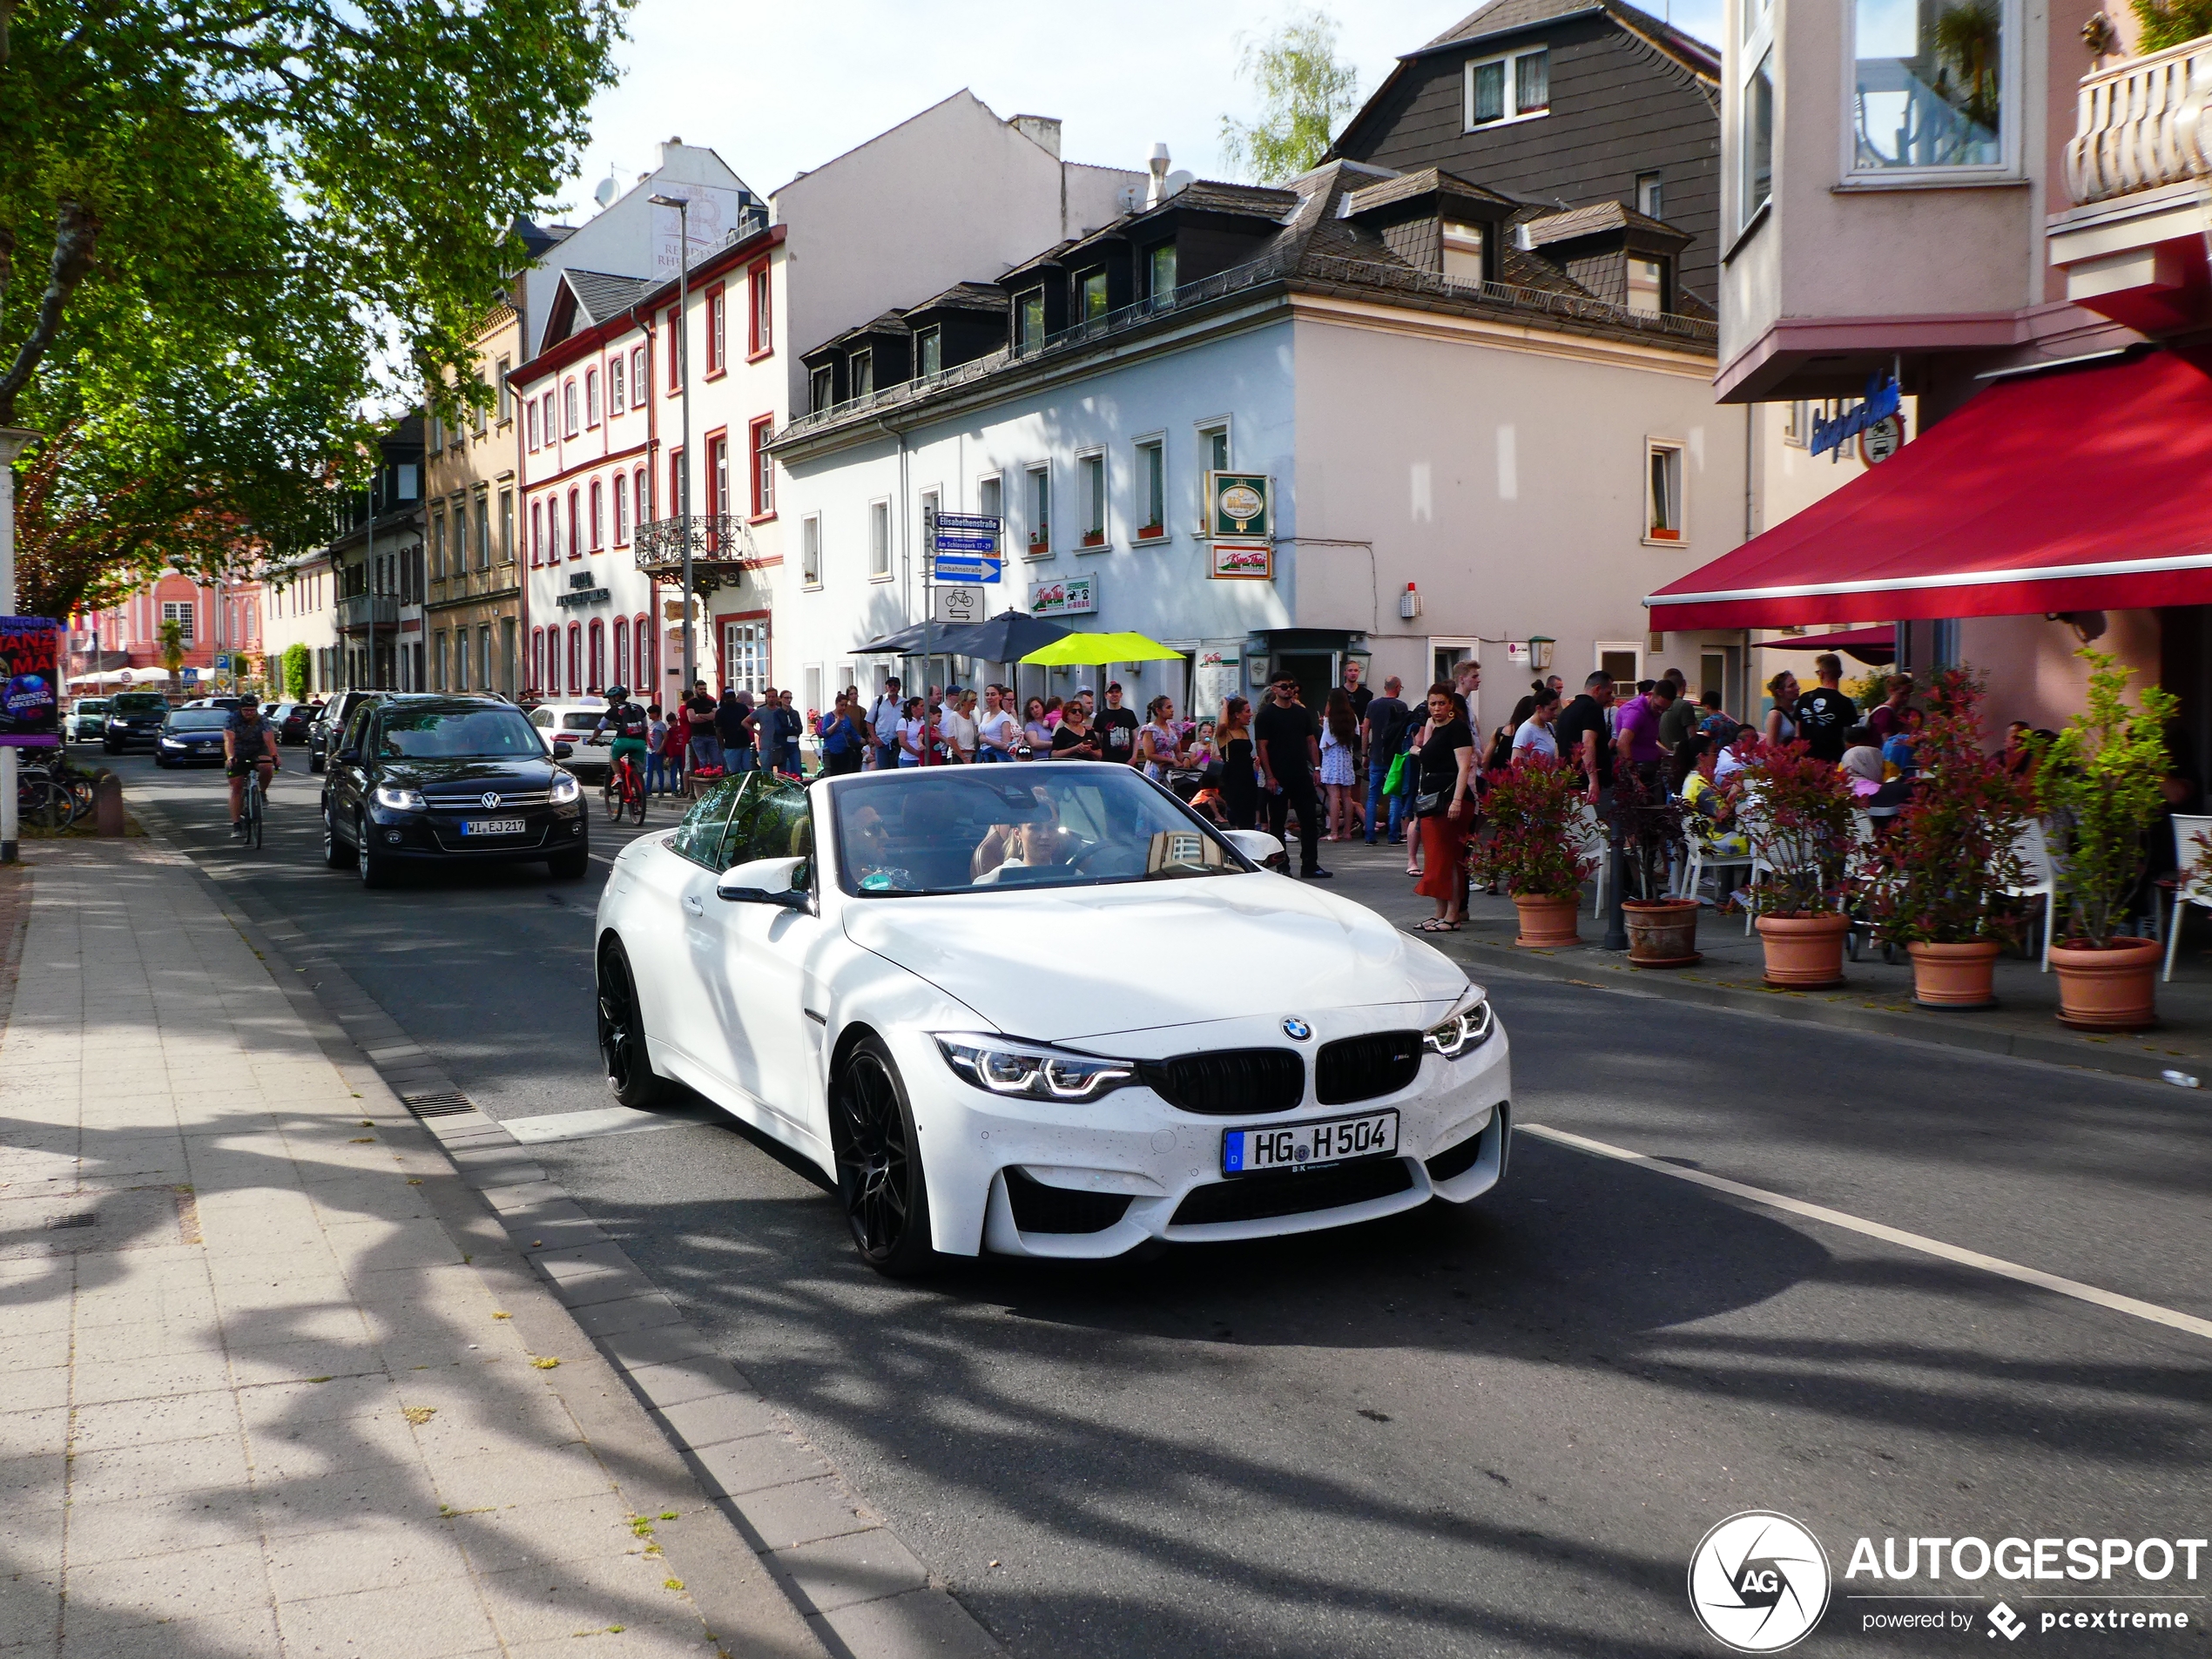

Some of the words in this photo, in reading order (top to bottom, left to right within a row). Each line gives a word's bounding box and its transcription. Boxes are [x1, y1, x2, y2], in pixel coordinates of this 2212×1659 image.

[940, 516, 997, 529] Elisabethenstraße
[938, 564, 982, 575] Einbahnstraße
[218, 658, 226, 667] P
[10, 691, 48, 702] ABSINTO
[7, 697, 53, 709] ORKESTRA
[468, 823, 482, 833] WI
[489, 822, 503, 833] EJ
[505, 820, 524, 831] 217
[1231, 1155, 1238, 1164] D
[1255, 1132, 1293, 1164] HG
[1313, 1127, 1332, 1158] H
[1338, 1119, 1385, 1154] 504
